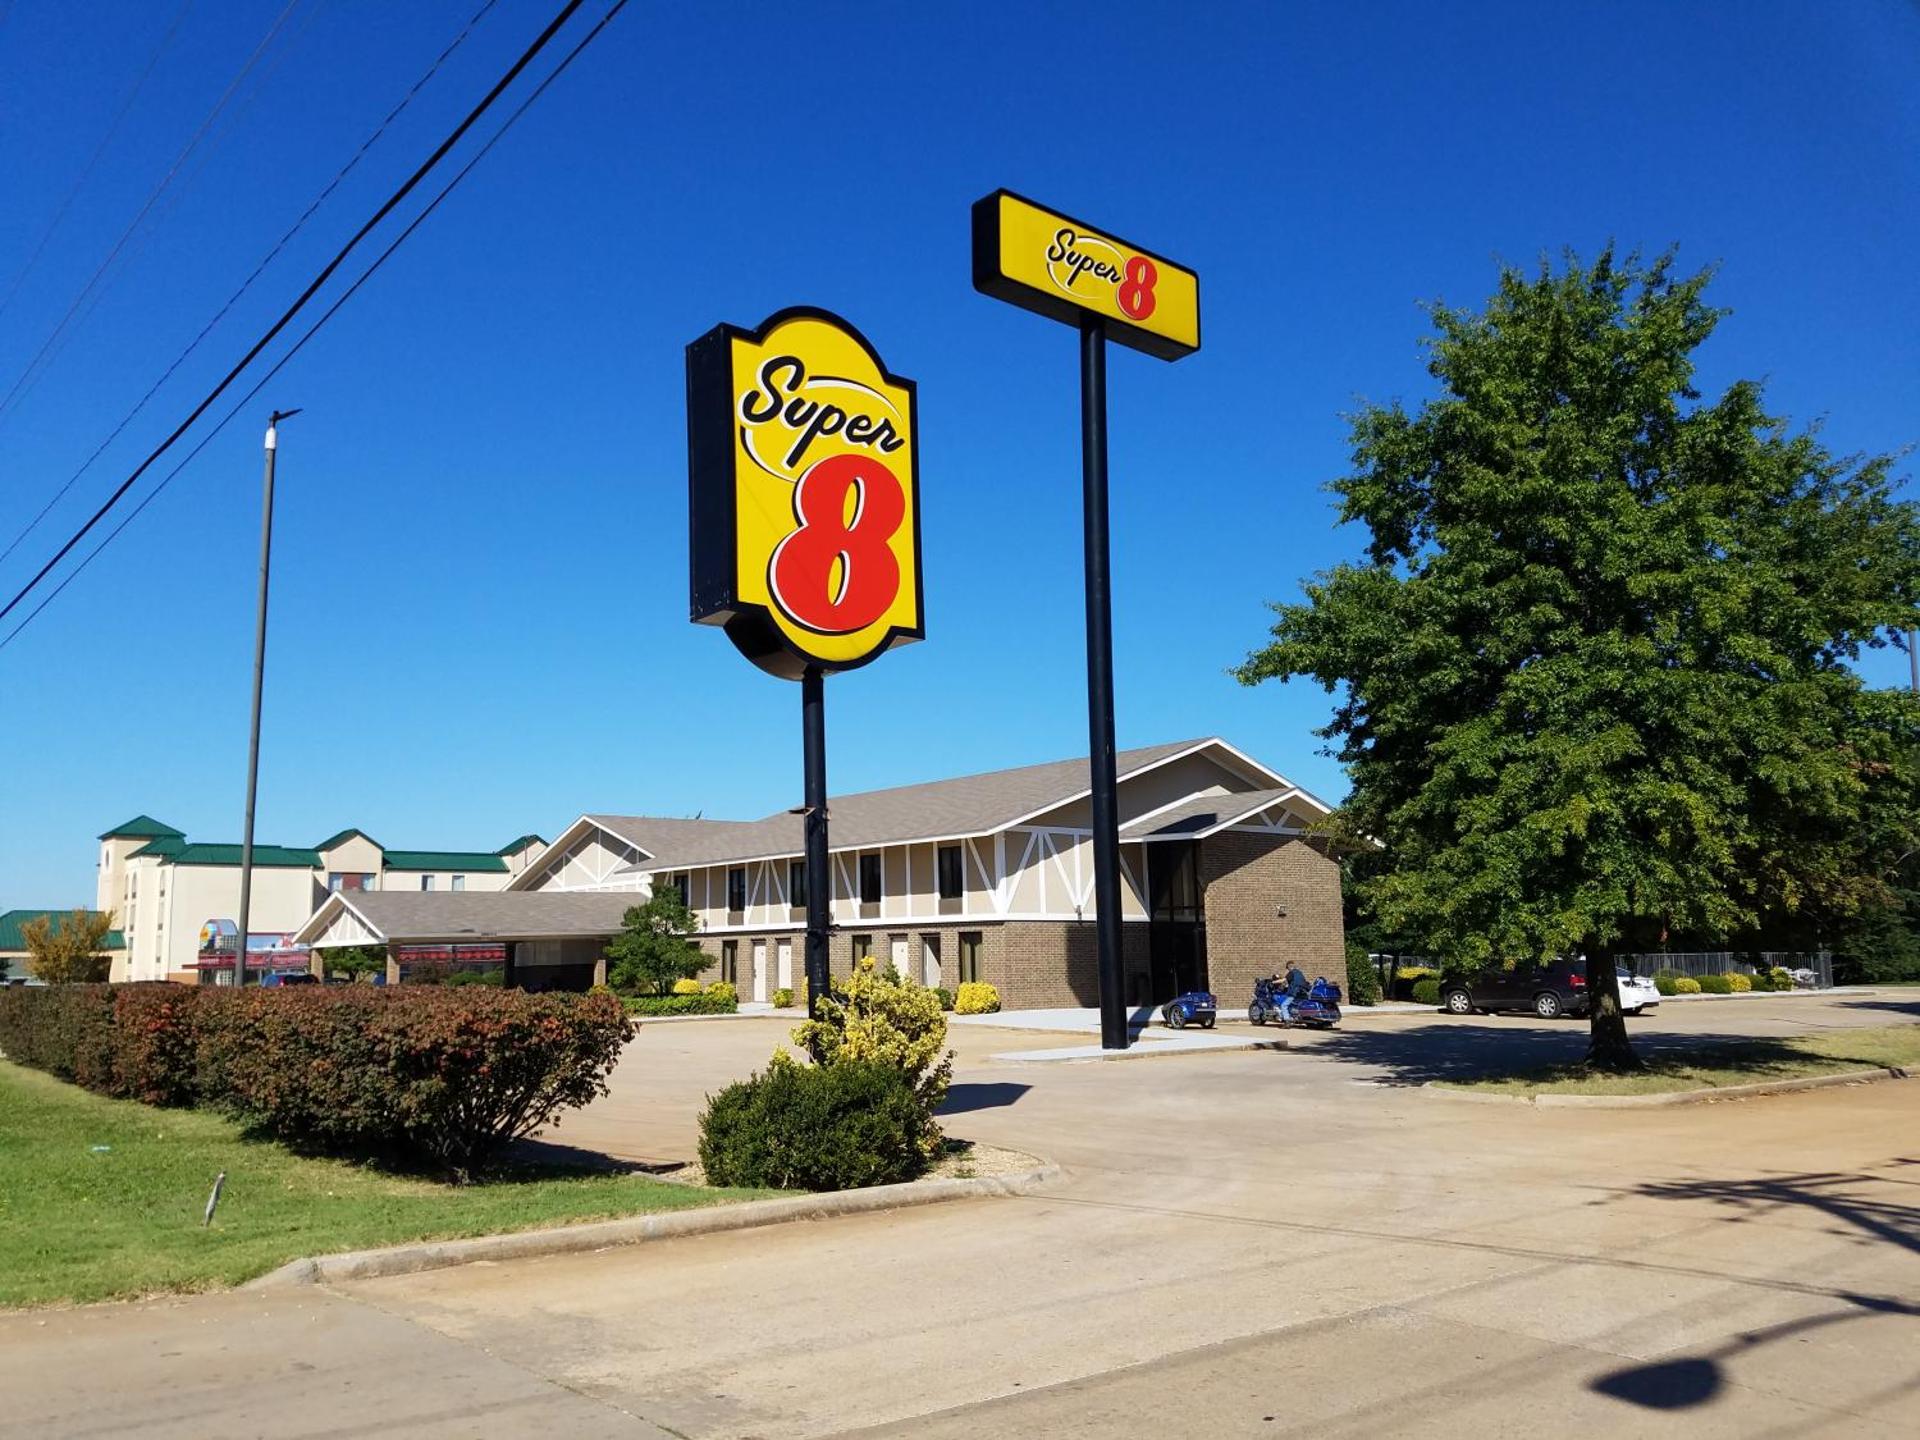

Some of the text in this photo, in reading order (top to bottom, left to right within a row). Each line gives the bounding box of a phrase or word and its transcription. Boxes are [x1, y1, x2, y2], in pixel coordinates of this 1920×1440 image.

[1047, 228, 1158, 321] Super 8
[740, 355, 905, 469] Super
[766, 453, 906, 637] 8
